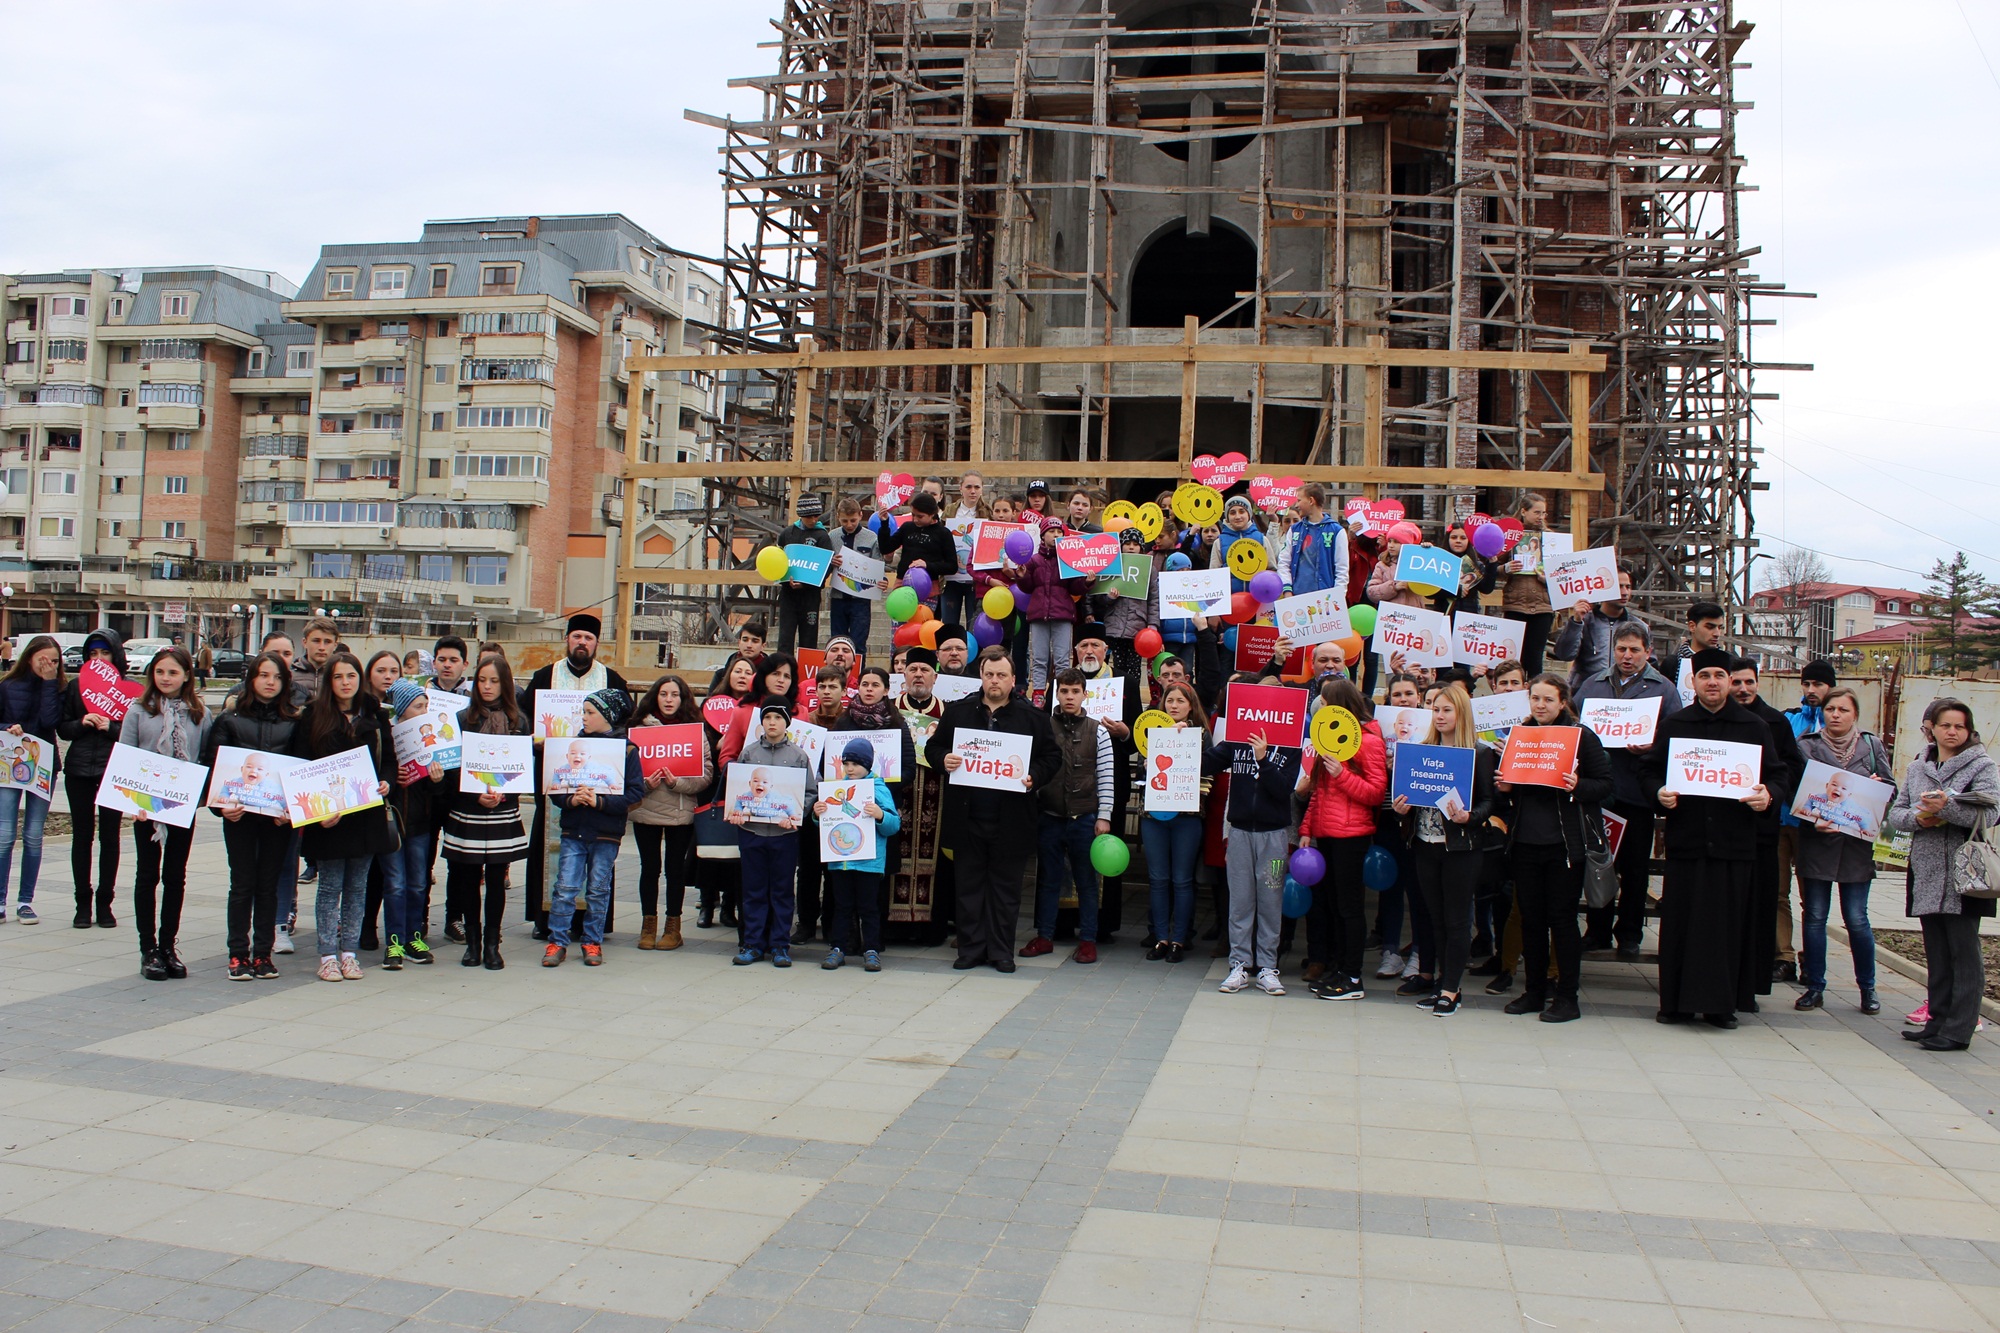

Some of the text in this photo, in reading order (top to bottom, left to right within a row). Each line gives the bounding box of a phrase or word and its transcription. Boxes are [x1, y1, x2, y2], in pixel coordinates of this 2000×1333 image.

[1215, 464, 1246, 473] FEMEIE
[1203, 476, 1236, 487] FAMILIE
[1270, 487, 1298, 497] FEMEI
[1369, 512, 1403, 521] FEMEIE
[1059, 539, 1085, 551] VIAȚĂ
[1085, 547, 1118, 556] FEMEIE
[1072, 559, 1108, 569] FAMILIE
[1409, 556, 1451, 578] DAR
[1559, 574, 1605, 595] viața
[1285, 619, 1343, 640] SUNT IUBIRE
[1384, 627, 1424, 652] viața
[1463, 637, 1507, 661] viața
[89, 660, 120, 686] VIAȚĂ
[81, 688, 123, 720] FAMILIE
[706, 697, 734, 711] VIAȚĂ
[1237, 707, 1295, 725] FAMILIE
[1594, 719, 1643, 740] viața
[974, 738, 1002, 748] Bărbații
[1515, 740, 1567, 750] Pentru femeie,
[438, 749, 456, 760] 76 %
[638, 743, 693, 759] IUBIRE
[963, 750, 977, 759] aleg
[1514, 751, 1560, 761] pentru copil,
[1694, 746, 1727, 757] Bărbații
[308, 761, 330, 772] MAMA
[336, 752, 361, 765] COPILUL!
[501, 762, 525, 772] VIAȚĂ
[964, 755, 1014, 780] viața
[1422, 757, 1445, 770] Viața
[1511, 761, 1557, 772] pentru viață.
[1681, 759, 1699, 768] aleg
[307, 767, 329, 779] DEPIND
[329, 765, 338, 773] DE
[1410, 767, 1454, 781] înseamnă
[1684, 763, 1742, 789] viața
[112, 774, 190, 802] MARȘUL VIAȚĂ
[1409, 780, 1451, 793] dragoste
[1174, 791, 1194, 801] BATE
